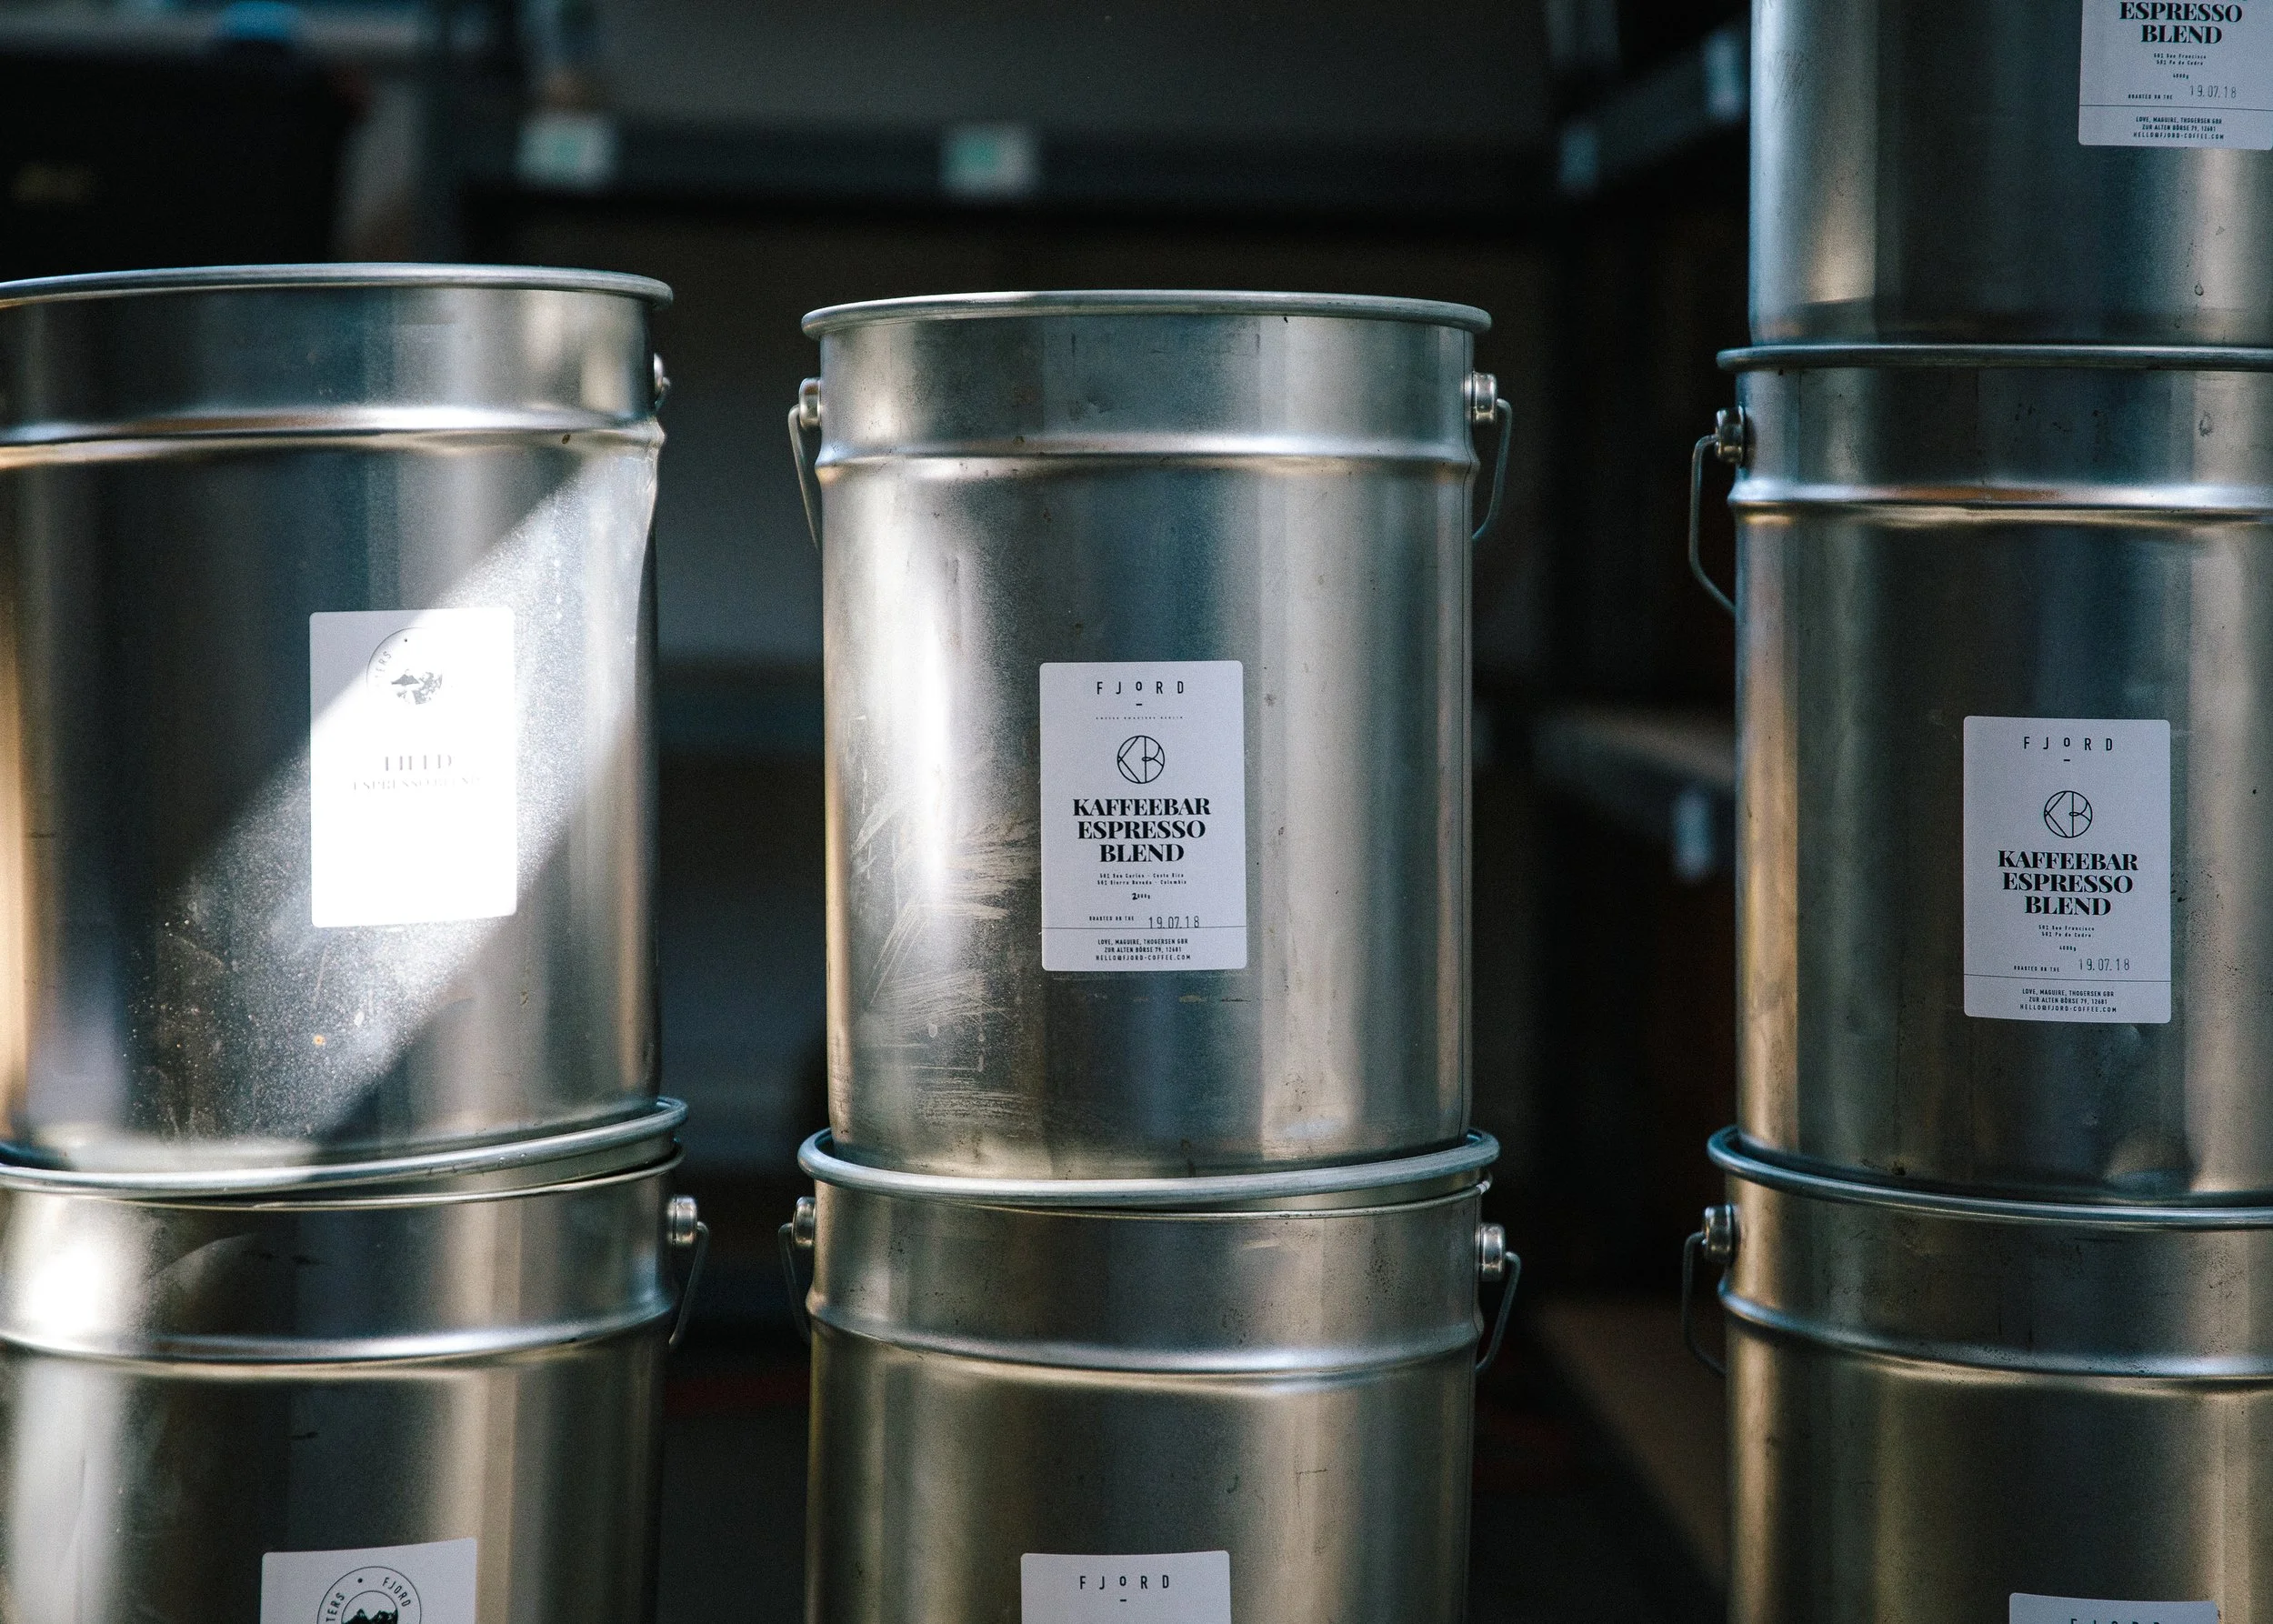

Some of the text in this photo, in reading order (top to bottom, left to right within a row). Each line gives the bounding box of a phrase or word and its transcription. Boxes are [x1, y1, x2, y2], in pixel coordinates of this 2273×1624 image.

[2119, 2, 2243, 23] ESPRESSO
[2141, 25, 2222, 44] BLEND
[2190, 84, 2237, 99] 19.07.18
[1096, 681, 1185, 695] FJORD
[2024, 736, 2114, 751] FJORD
[1073, 797, 1212, 817] KAFFEEBAR
[1077, 819, 1207, 839] ESPRESSO
[1099, 843, 1185, 863] BLEND
[1998, 850, 2139, 871] KAFFEEBAR
[2002, 872, 2134, 894] ESPRESSO
[2024, 896, 2112, 916] BLEND
[1148, 915, 1200, 929] 19.07.18
[2078, 957, 2130, 971] 19.07.18
[2019, 1004, 2117, 1013] HELLO@FJORD-COFFEE.COM
[1080, 1575, 1169, 1590] FJORD
[382, 1577, 411, 1608] FJORD
